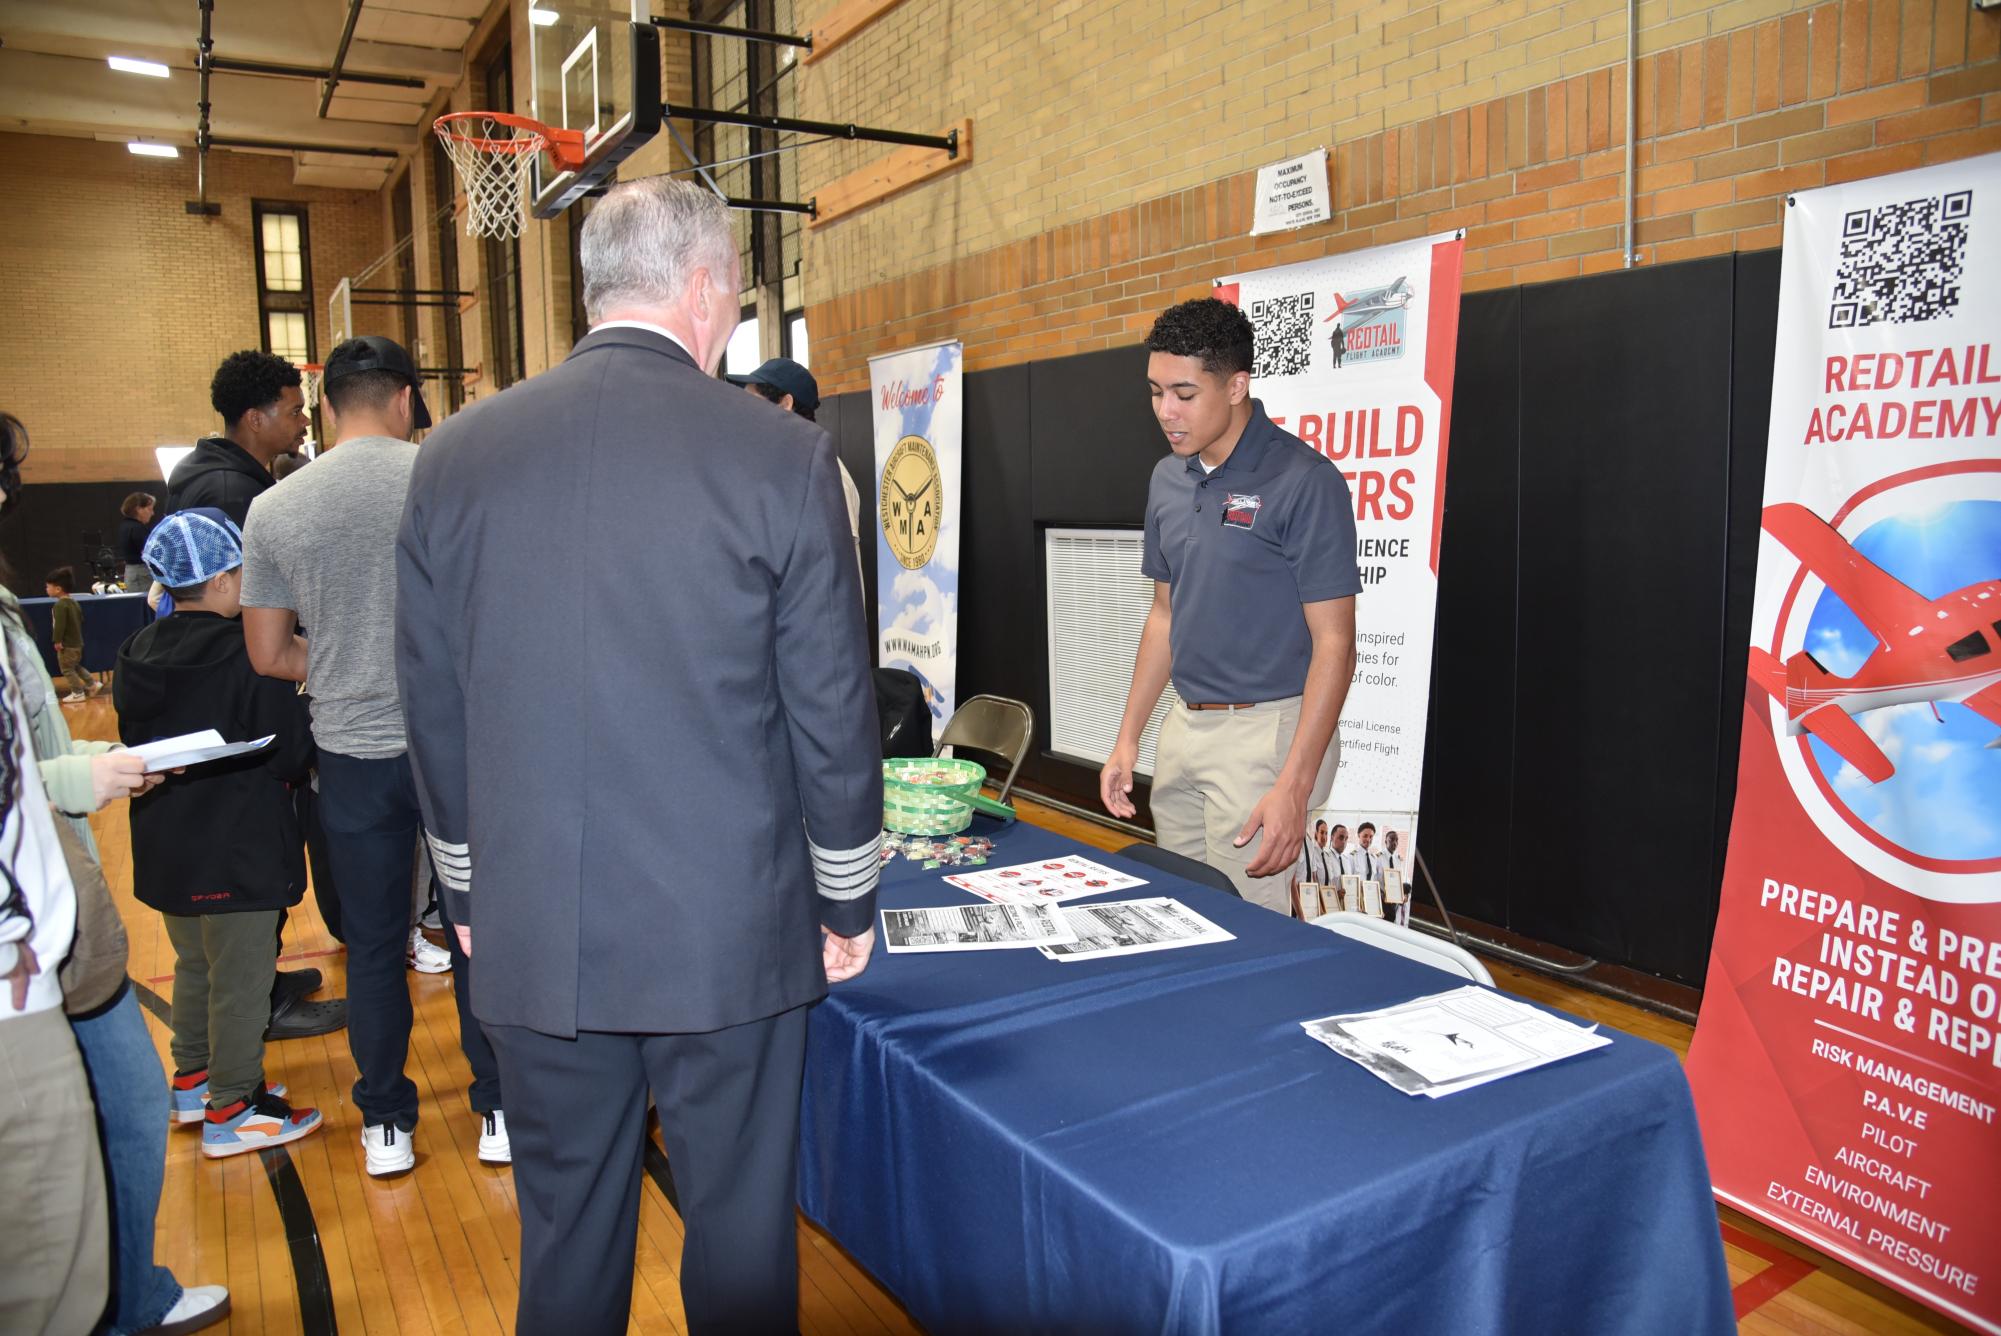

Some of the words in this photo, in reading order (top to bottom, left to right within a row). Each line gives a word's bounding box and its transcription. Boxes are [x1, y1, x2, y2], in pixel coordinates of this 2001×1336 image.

[1274, 175, 1307, 190] OCCUPANCY
[1277, 163, 1303, 177] MAXIMUM
[1346, 321, 1401, 351] REDTAIL
[1346, 350, 1367, 361] FLIGHT
[1372, 346, 1400, 357] ACADEMY
[1825, 343, 2001, 394] REDTAIL
[881, 380, 929, 411] Welcome
[932, 374, 945, 402] to
[1298, 405, 1424, 461] BUILD
[1803, 397, 2001, 445] ACADEMY
[881, 469, 893, 530] WESTCHESTER
[1356, 630, 1405, 646] inspired
[1351, 670, 1363, 684] of
[1365, 673, 1398, 688] color.
[1382, 652, 1399, 666] for
[1366, 720, 1401, 734] License
[1374, 742, 1399, 757] Flight
[1761, 878, 1900, 944] PREPARE
[1909, 919, 1928, 955] &
[1772, 957, 1883, 1021] REPAIR
[1893, 998, 1915, 1033] &
[1819, 933, 1958, 1005] INSTEAD
[1970, 983, 2001, 1023] O
[1812, 1039, 1853, 1068] RISK
[1856, 1055, 1996, 1124] MANAGEMENT
[1863, 1090, 1927, 1130] P.A.V.E
[1861, 1122, 1917, 1158] PILOT
[1834, 1146, 1932, 1200] AIRCRAFT
[1804, 1165, 1950, 1243] ENVIRONMENT
[1767, 1181, 1862, 1240] EXTERNAL
[1867, 1228, 1979, 1295] PRESSURE
